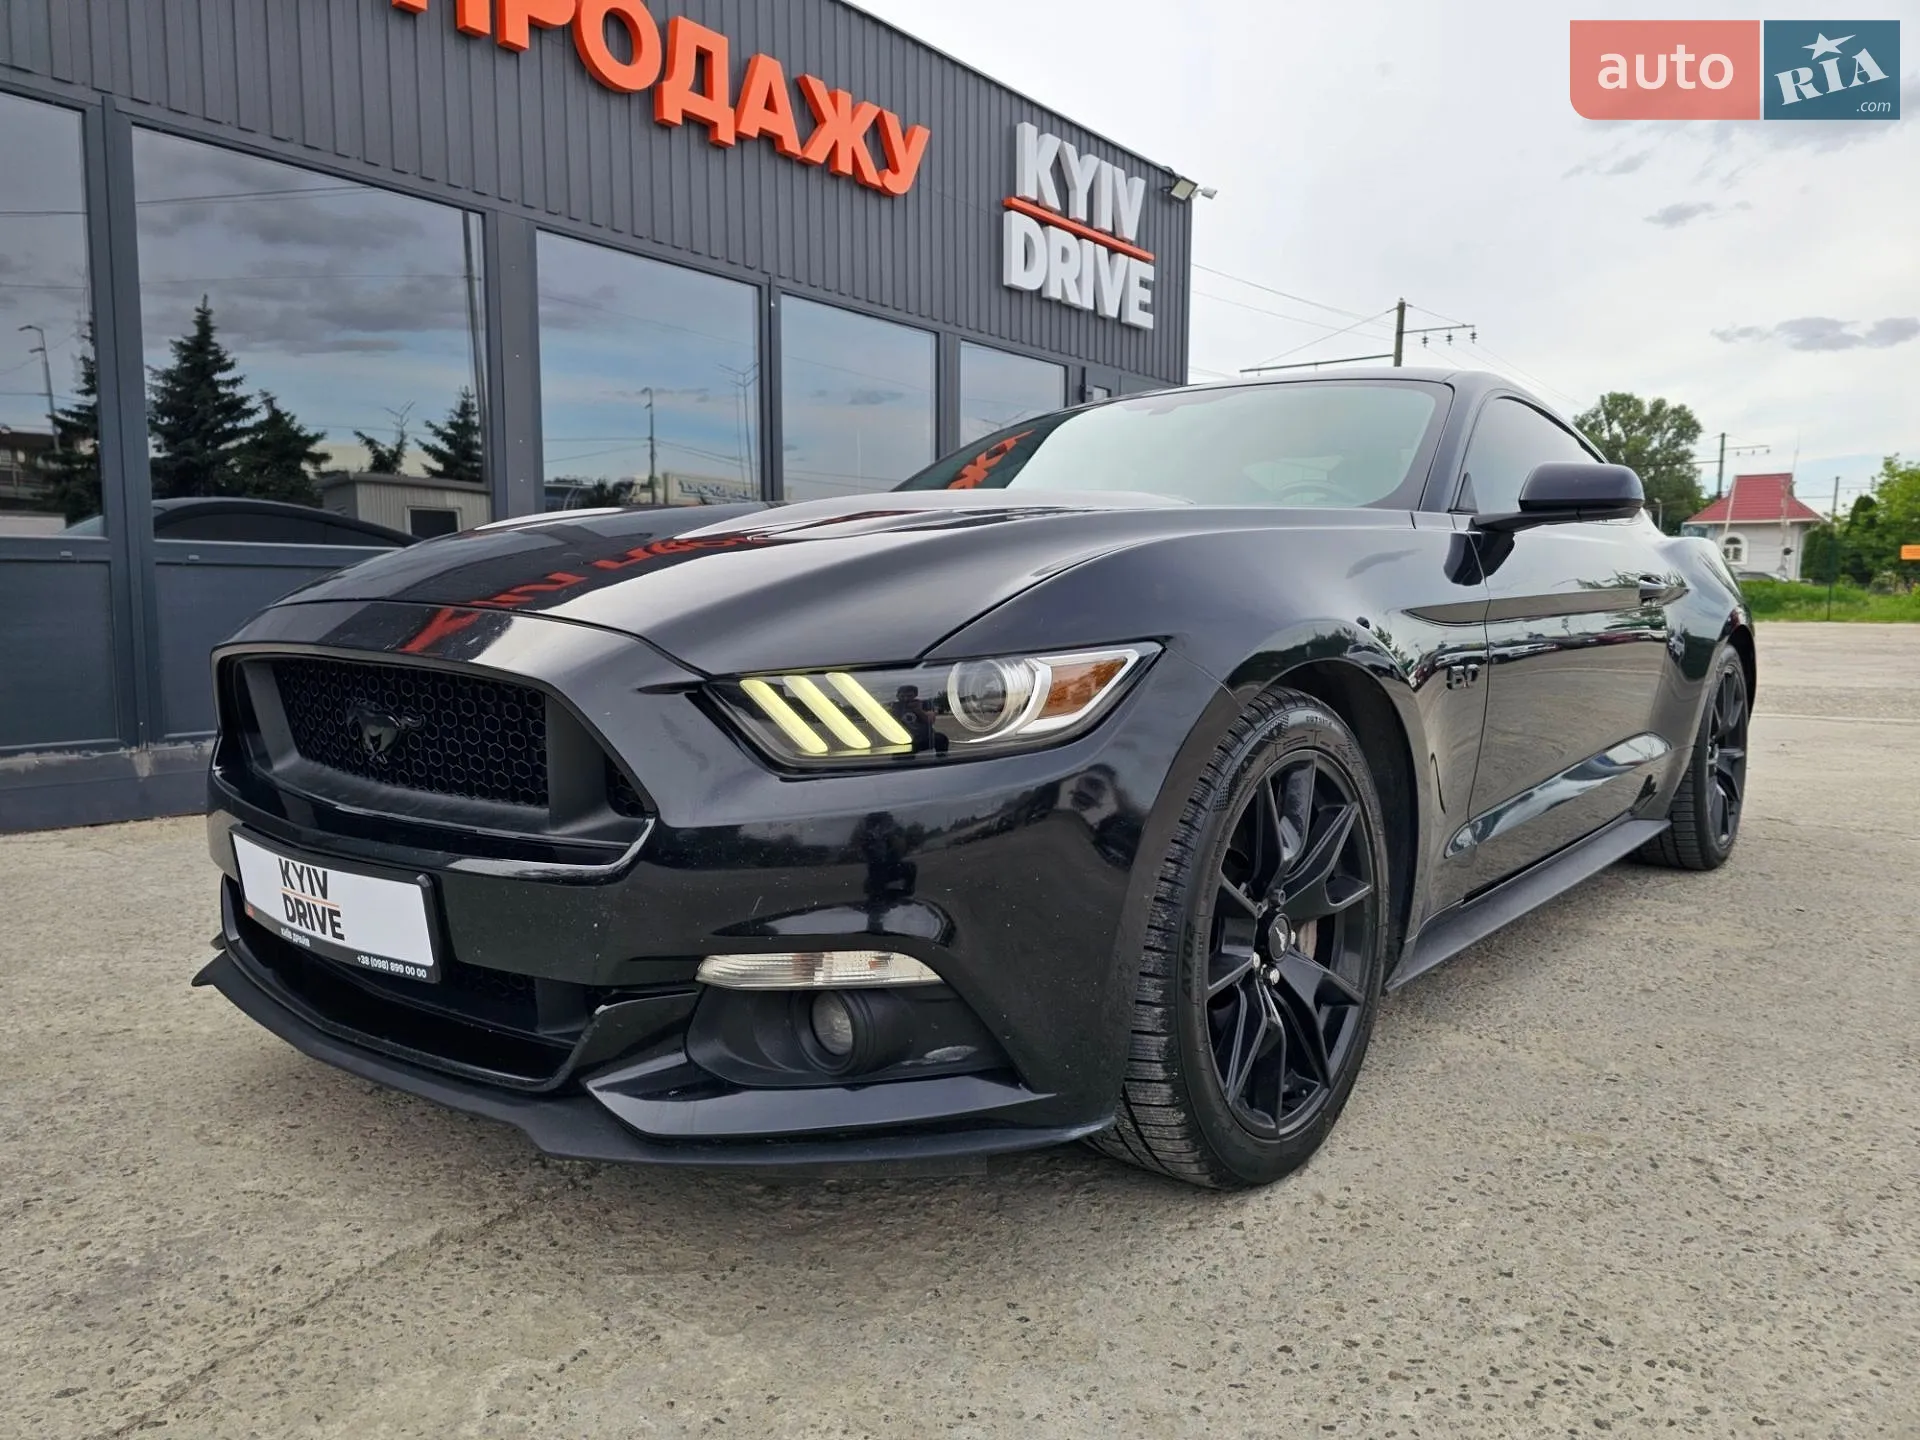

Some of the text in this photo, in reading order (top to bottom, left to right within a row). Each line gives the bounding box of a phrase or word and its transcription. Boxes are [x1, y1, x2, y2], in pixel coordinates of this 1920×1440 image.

[391, 0, 930, 196] ОДАЖУ
[1016, 122, 1146, 243] KYIV
[1003, 210, 1155, 329] DRIVE
[278, 858, 328, 900] KYIV
[282, 893, 345, 941] DRIVE
[405, 965, 415, 976] 00
[416, 967, 427, 978] 00
